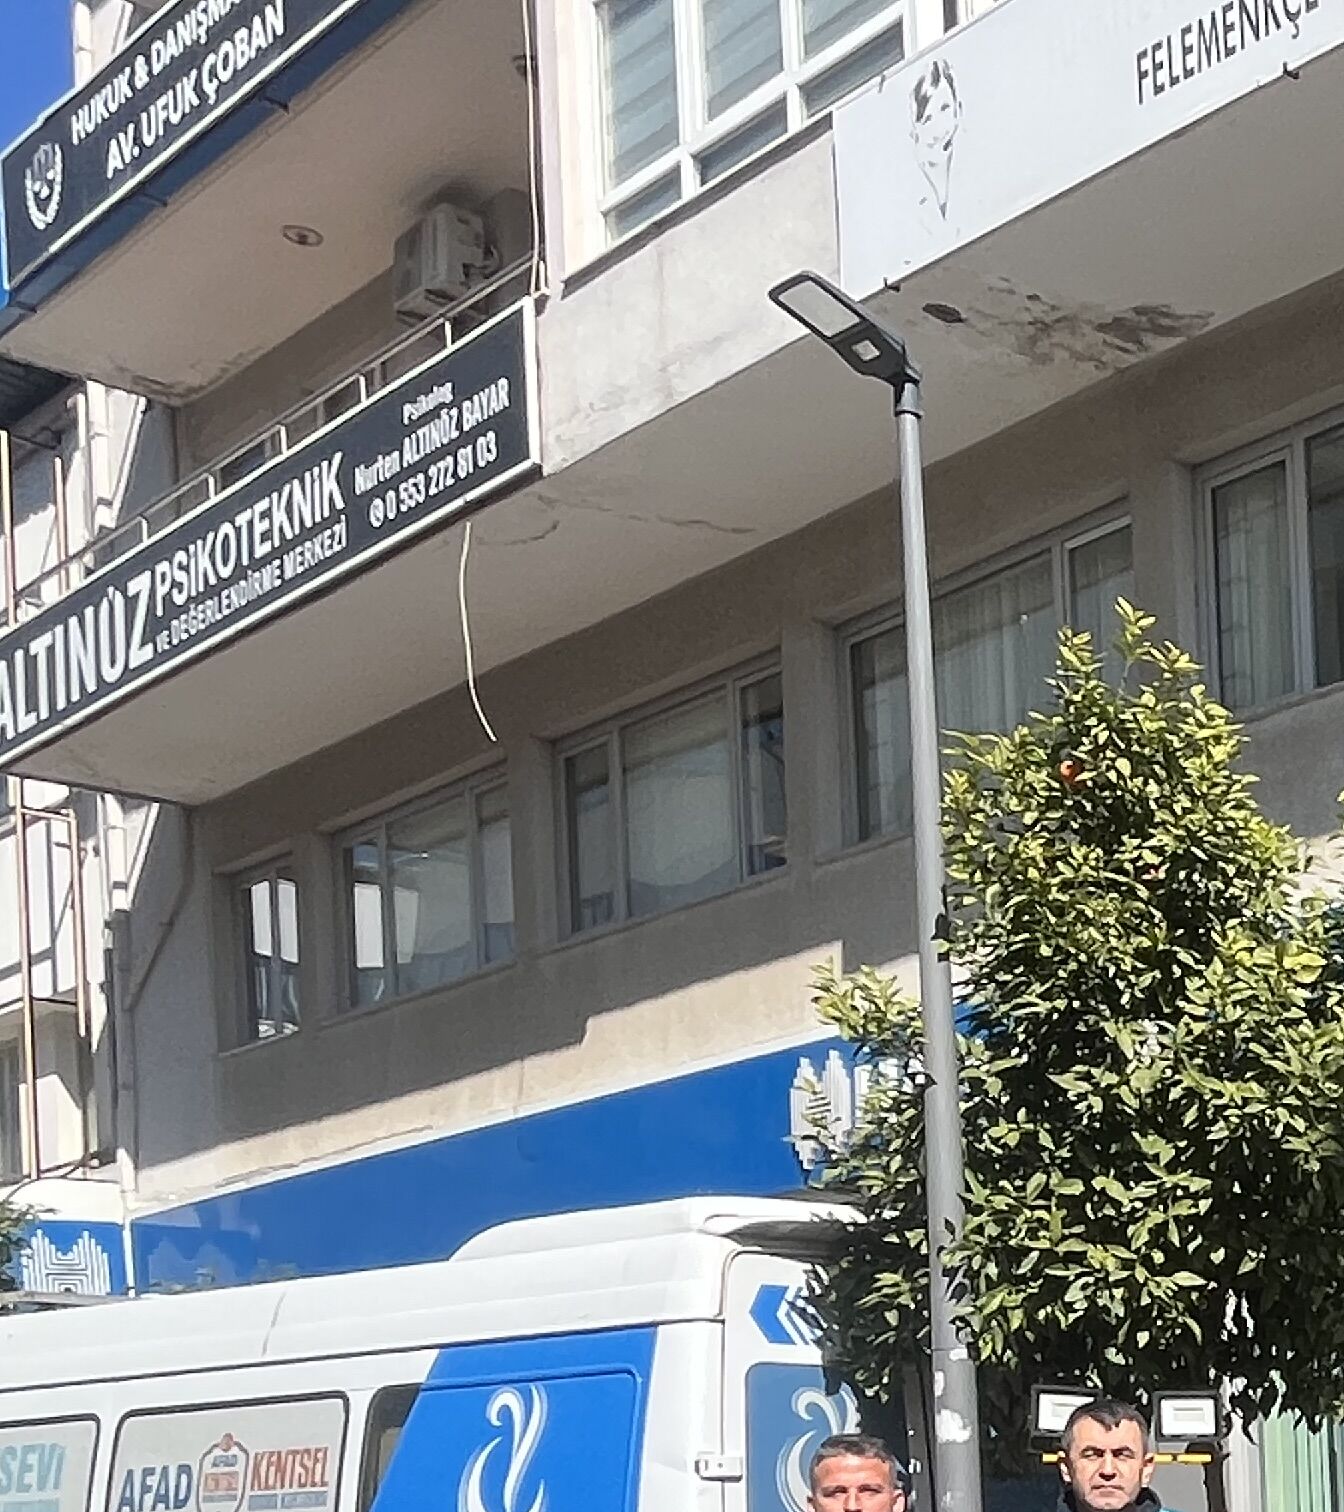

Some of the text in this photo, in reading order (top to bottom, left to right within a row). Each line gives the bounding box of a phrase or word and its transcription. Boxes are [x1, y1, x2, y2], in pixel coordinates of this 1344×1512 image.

[71, 0, 241, 146] HUKUK & DANIŞM
[106, 0, 284, 180] AV. UFUK ÇOBAN
[1136, 0, 1321, 105] FELEMENKÇ
[354, 377, 511, 495] Nurten ALTINÖZ BAYAR
[385, 489, 397, 520] 0
[428, 455, 455, 496] 272
[476, 430, 498, 468] 03
[154, 451, 345, 618] PSİKOTEKNİK
[281, 514, 348, 581] MERKEZİ
[250, 1446, 329, 1492] KENTSEL
